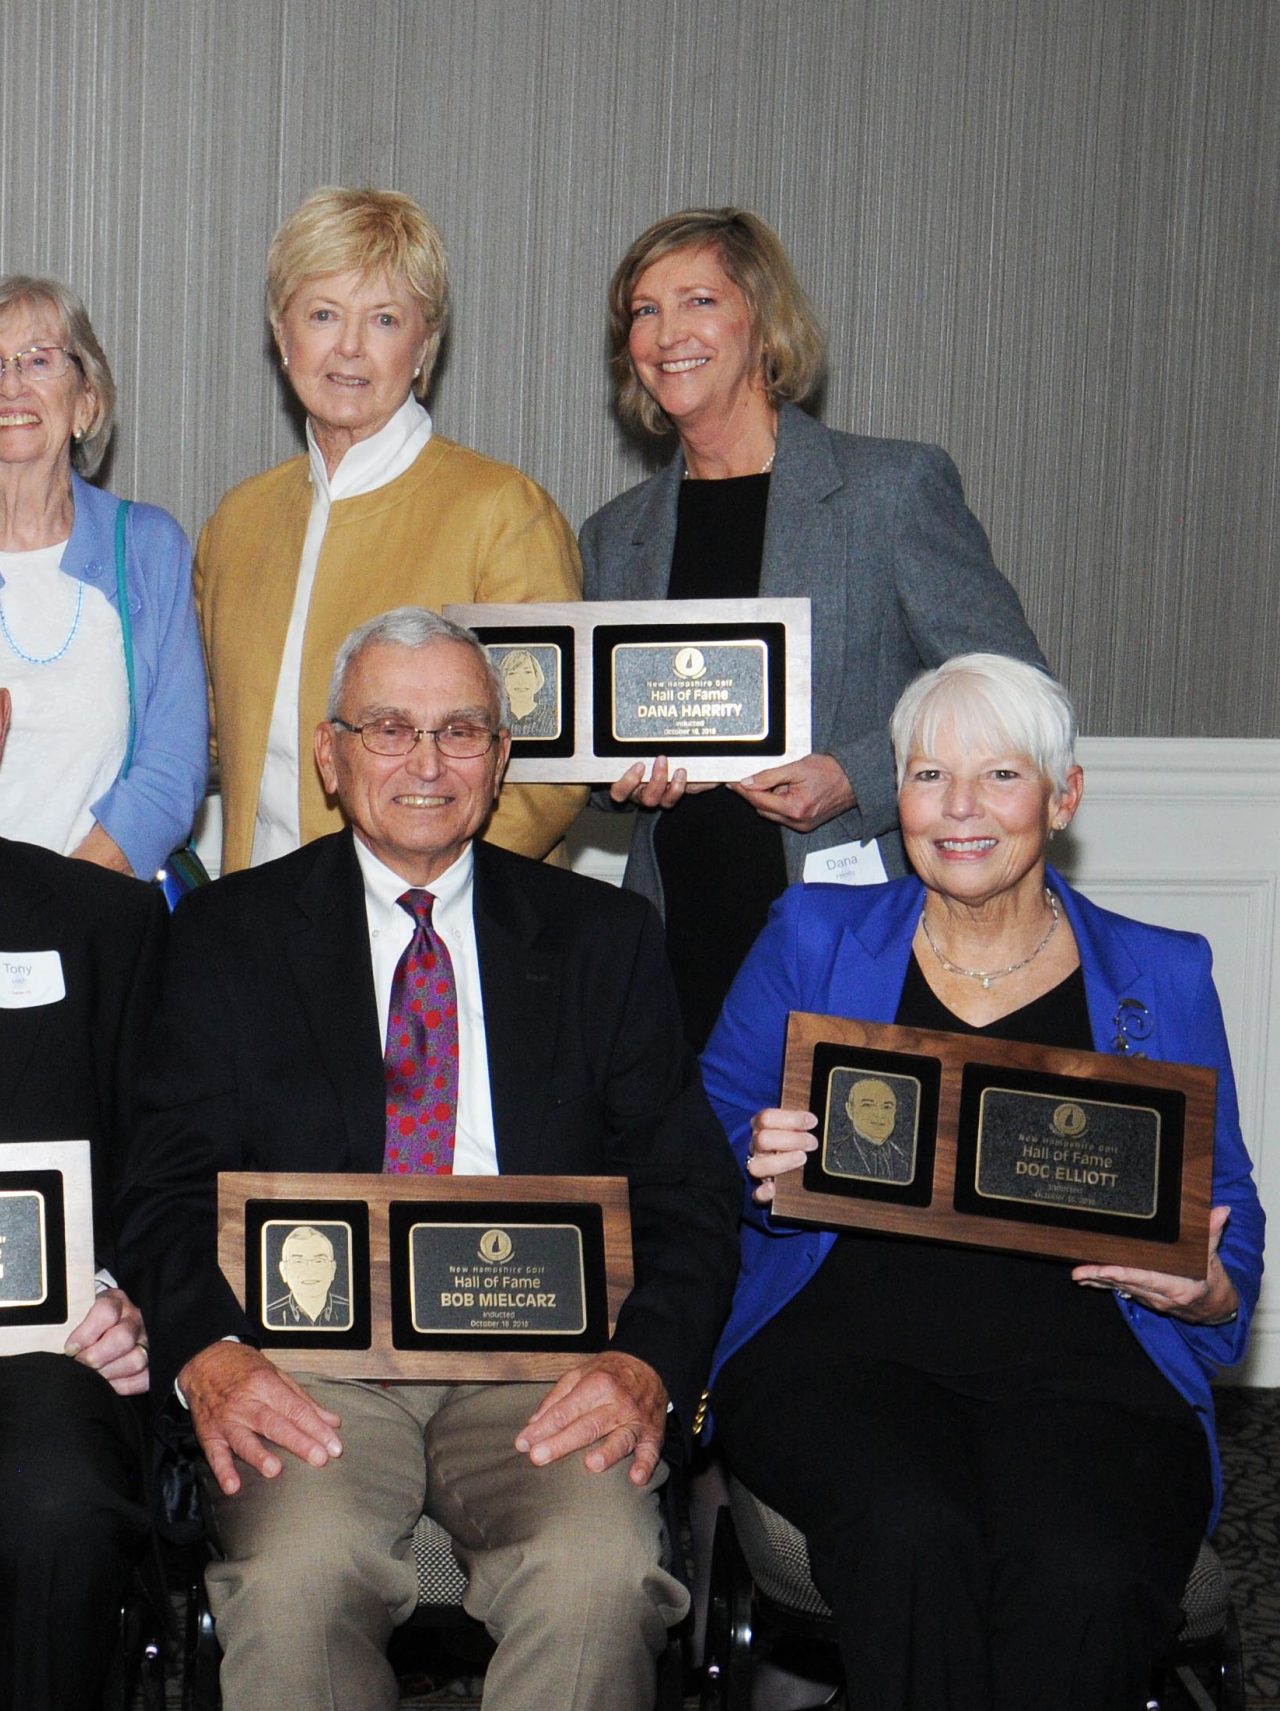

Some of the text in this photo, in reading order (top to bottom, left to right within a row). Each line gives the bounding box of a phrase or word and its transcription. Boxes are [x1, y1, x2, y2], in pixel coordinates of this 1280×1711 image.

[651, 689, 728, 701] Hall of Fame
[638, 703, 742, 717] DANA HARRITY
[826, 856, 858, 870] Dana
[3, 963, 32, 976] Tony
[1023, 1145, 1113, 1168] Hall of Fame
[1016, 1161, 1118, 1187] DOC ELLIOTT
[454, 1276, 540, 1288] Hall of Fame
[441, 1292, 556, 1307] BOB MIELCARZ
[470, 1320, 499, 1328] October
